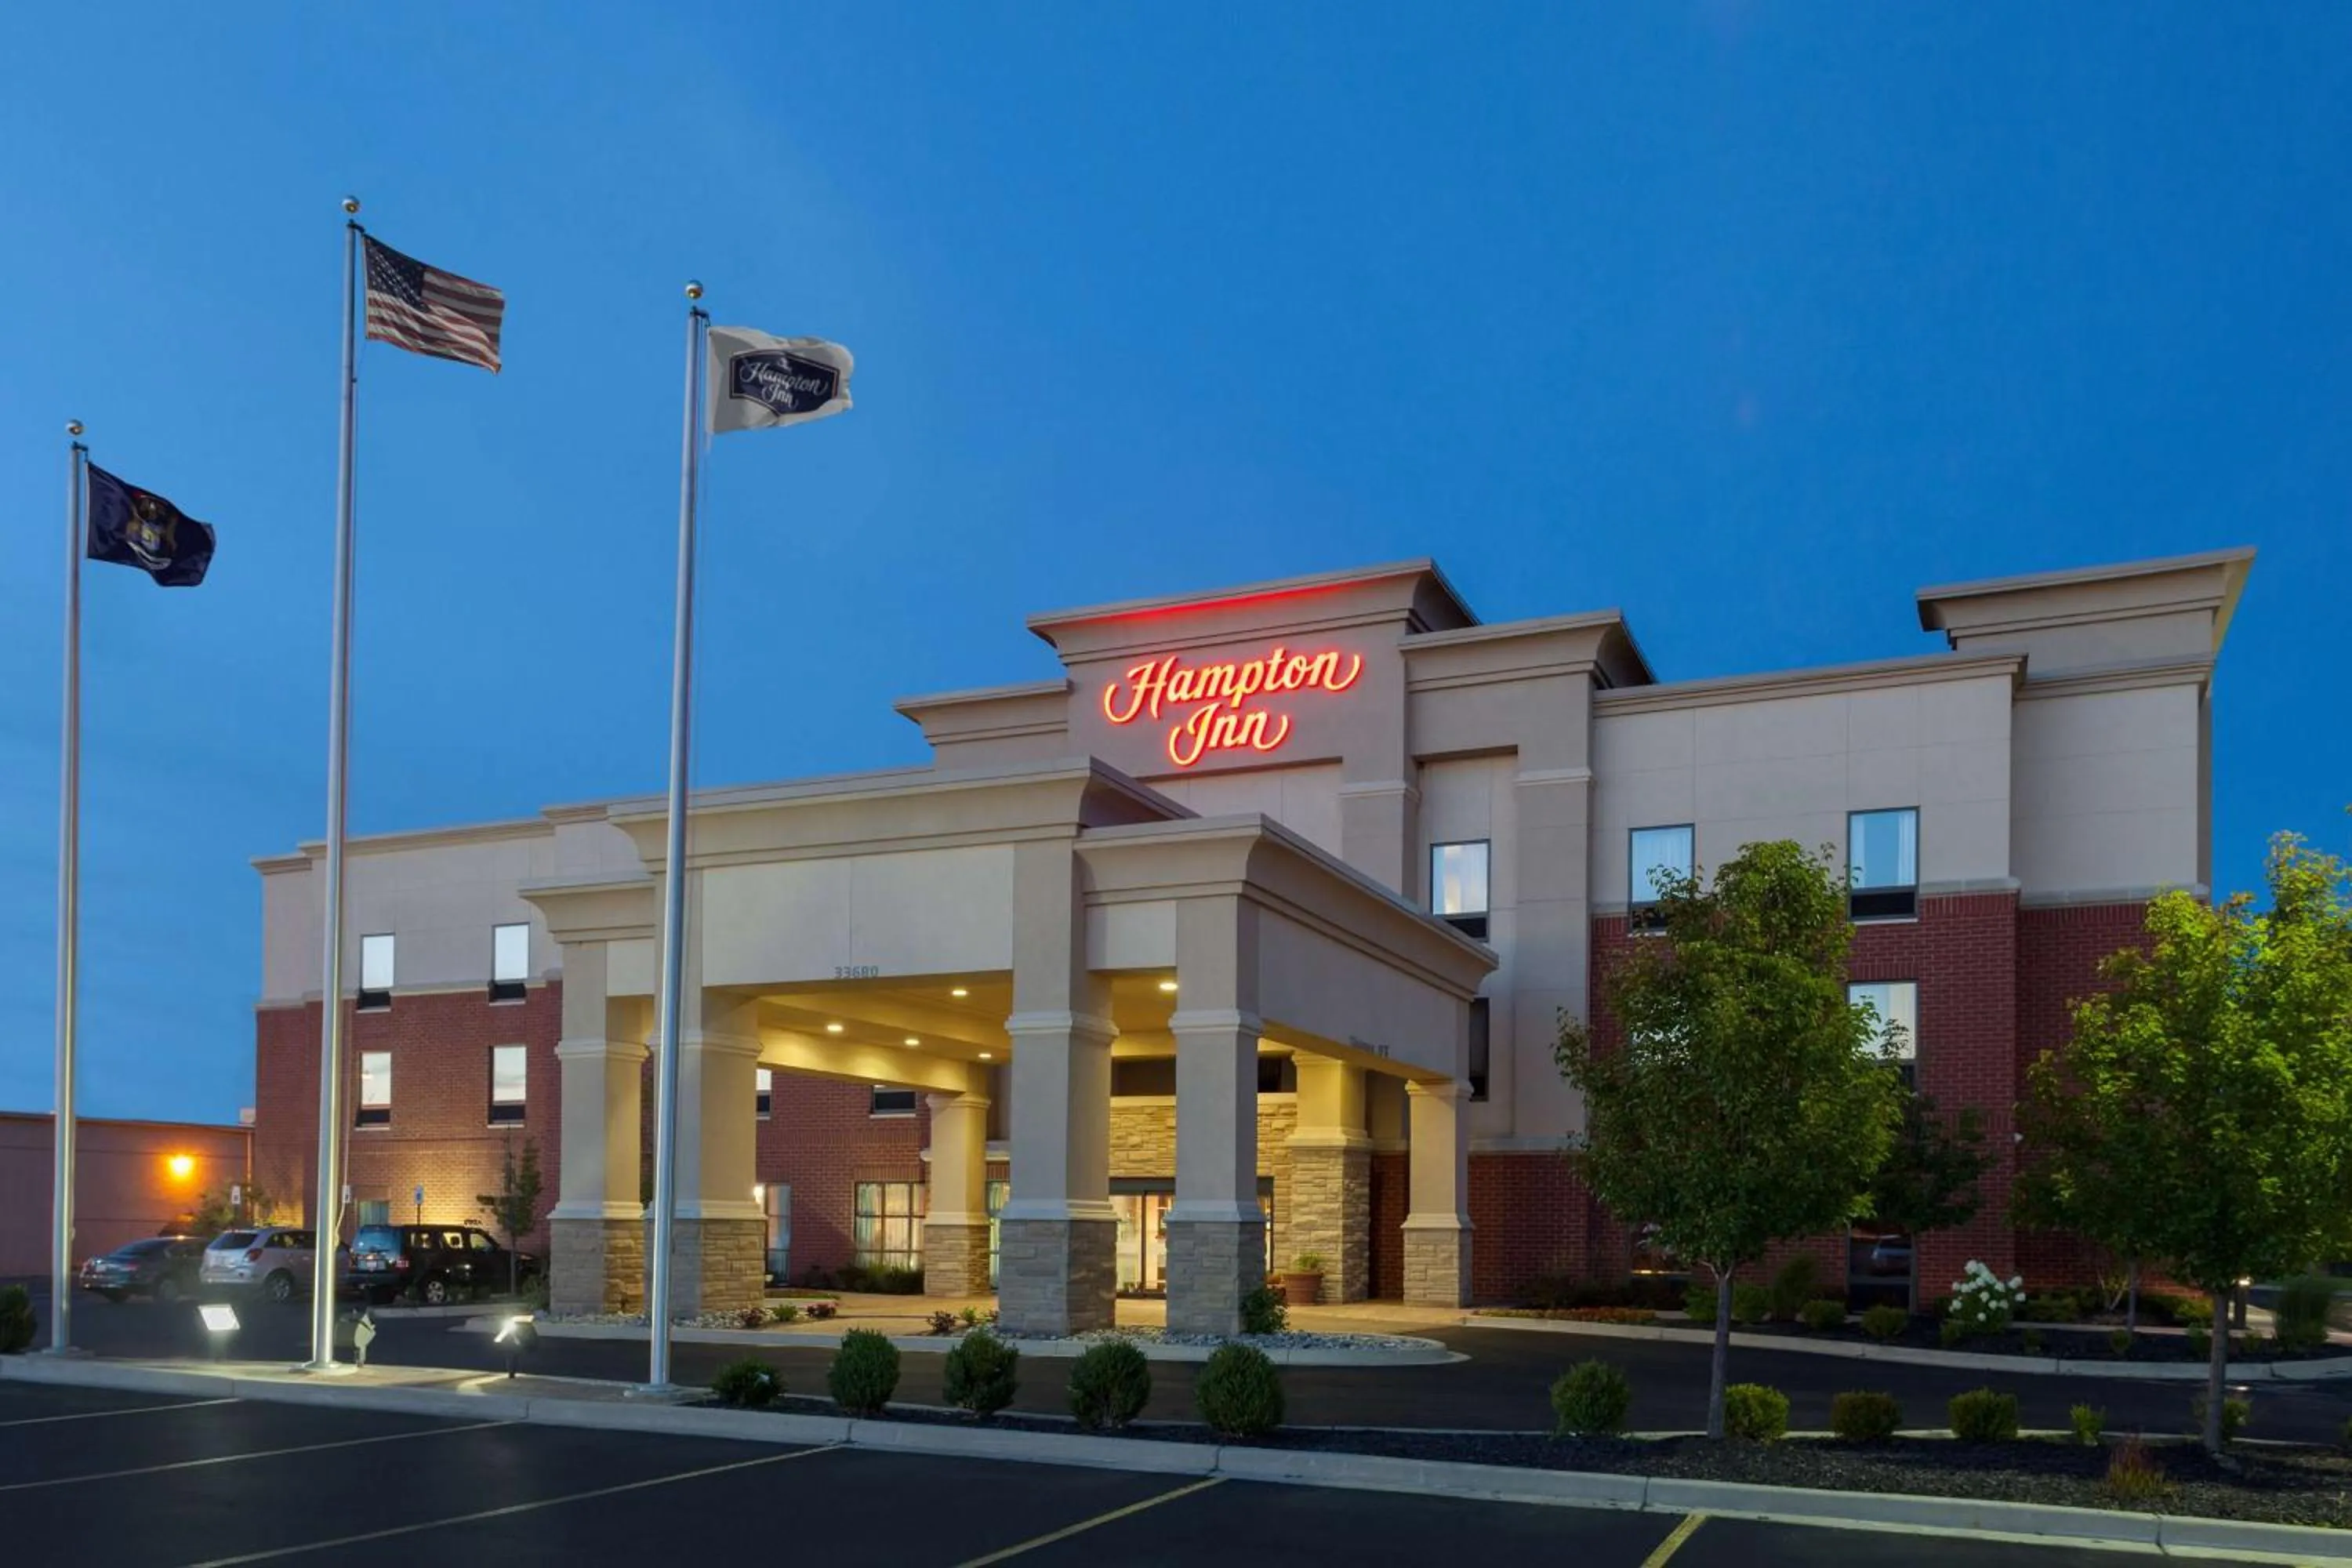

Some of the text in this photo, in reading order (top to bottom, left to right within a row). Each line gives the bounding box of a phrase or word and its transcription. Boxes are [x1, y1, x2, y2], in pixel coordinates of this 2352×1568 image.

[739, 361, 828, 395] Hampton
[762, 383, 798, 408] Inn
[1104, 647, 1361, 723] Hampton
[1168, 702, 1289, 766] Inn
